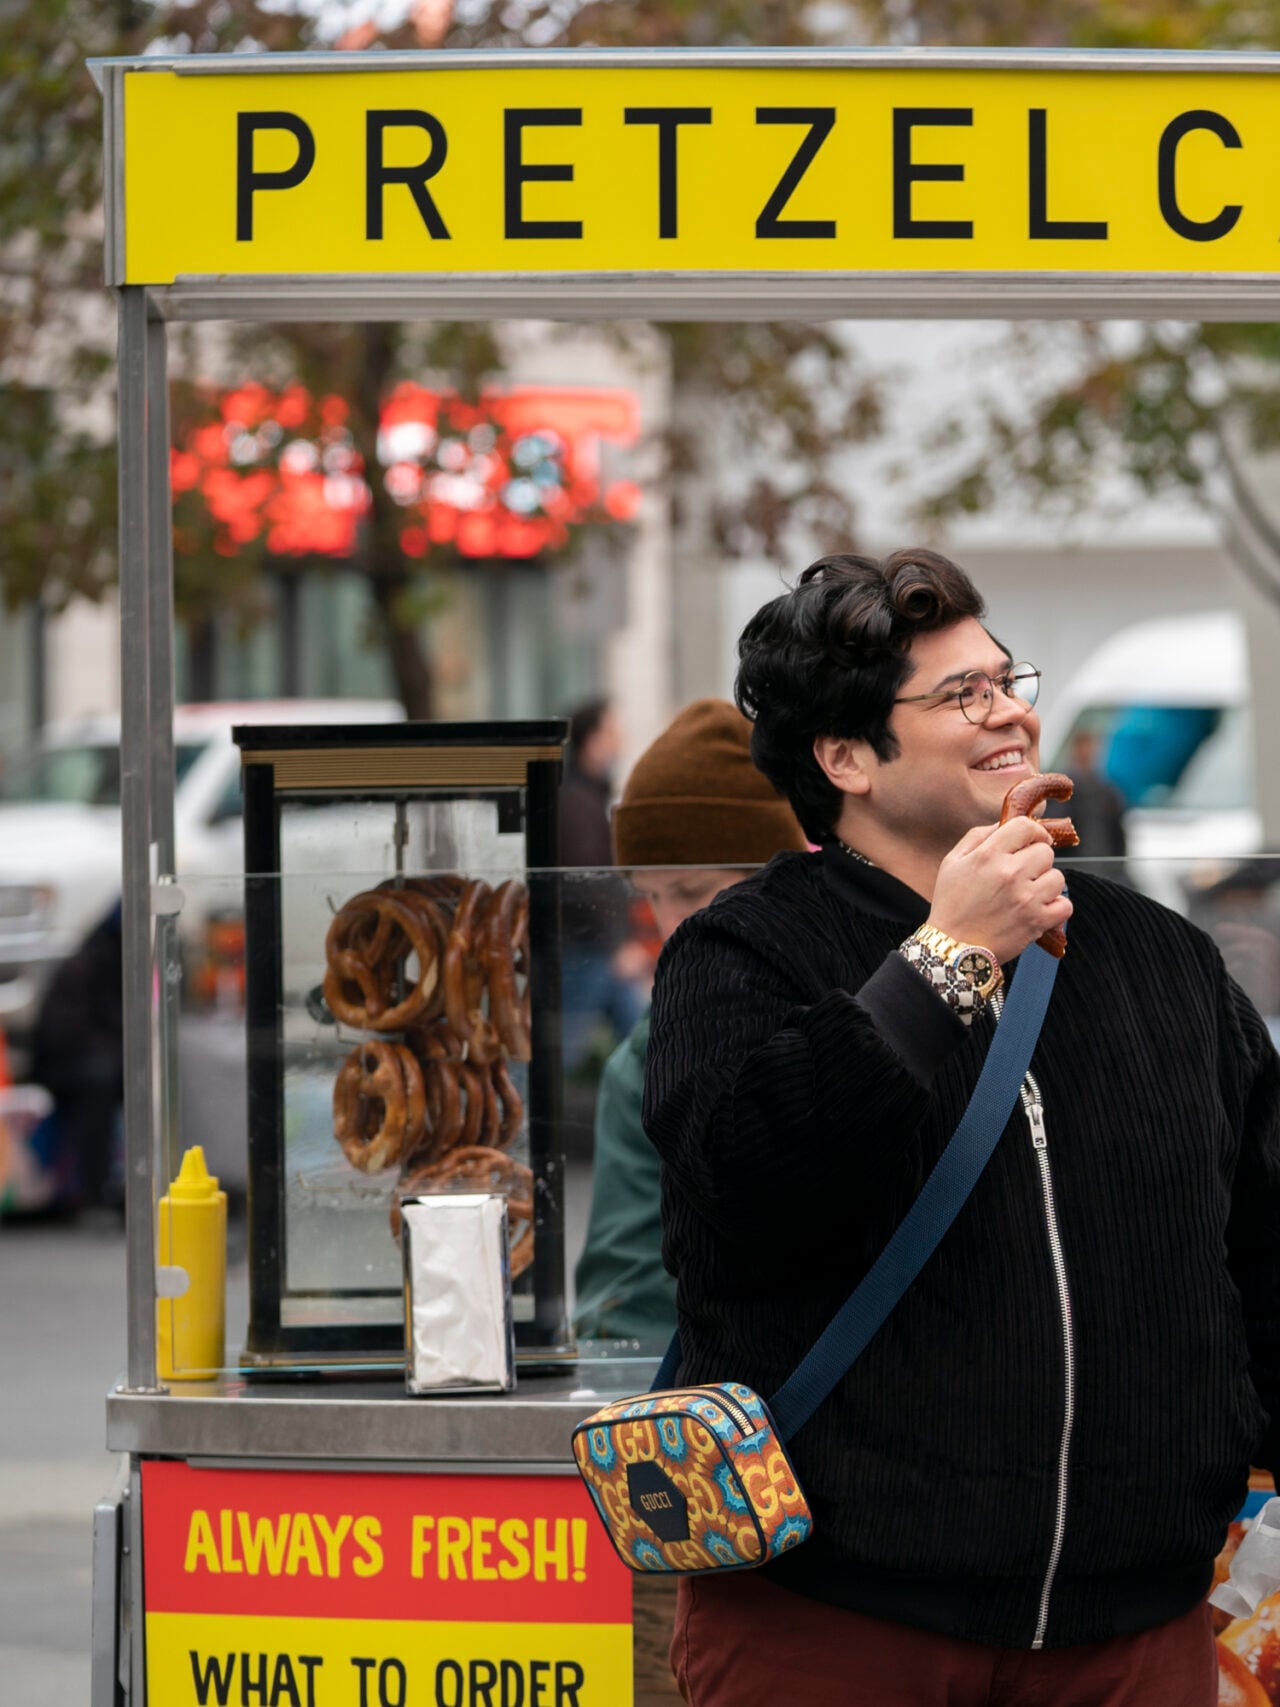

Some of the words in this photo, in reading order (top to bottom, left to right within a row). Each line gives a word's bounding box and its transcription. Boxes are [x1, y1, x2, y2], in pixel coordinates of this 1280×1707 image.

[640, 1491, 672, 1512] GUCCI
[184, 1510, 383, 1578] ALWAYS
[411, 1515, 588, 1581] FRESH!
[189, 1650, 323, 1707] WHAT
[351, 1657, 407, 1707] TO
[434, 1658, 586, 1707] ORDER
